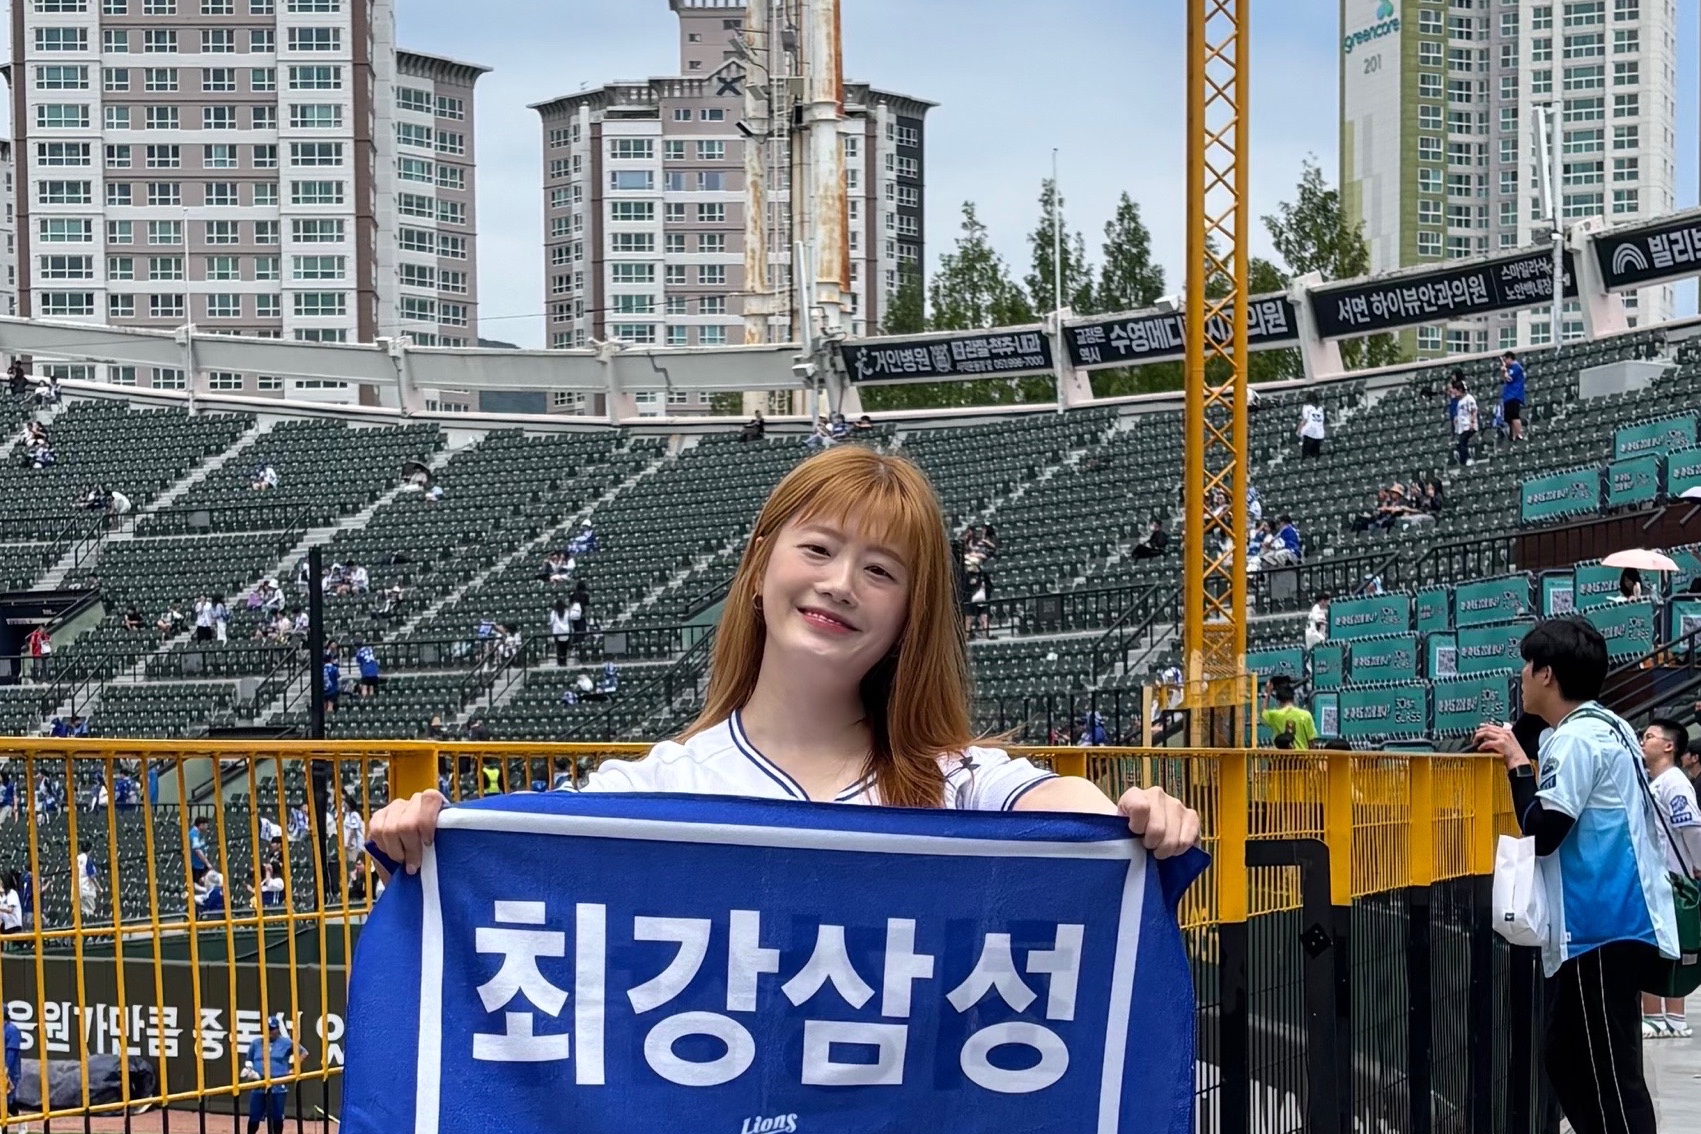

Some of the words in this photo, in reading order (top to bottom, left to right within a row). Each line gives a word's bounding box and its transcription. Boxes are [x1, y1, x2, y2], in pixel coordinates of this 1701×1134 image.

[1344, 18, 1399, 54] greencore
[1364, 53, 1381, 74] 201
[1337, 296, 1371, 326] 서면
[1370, 273, 1489, 320] 하이뷰안과의원
[1505, 275, 1553, 301] 노안백내장
[871, 347, 932, 374] 거인병원
[472, 899, 1086, 1094] 최강삼성
[6, 1000, 184, 1058] 응원가만큼
